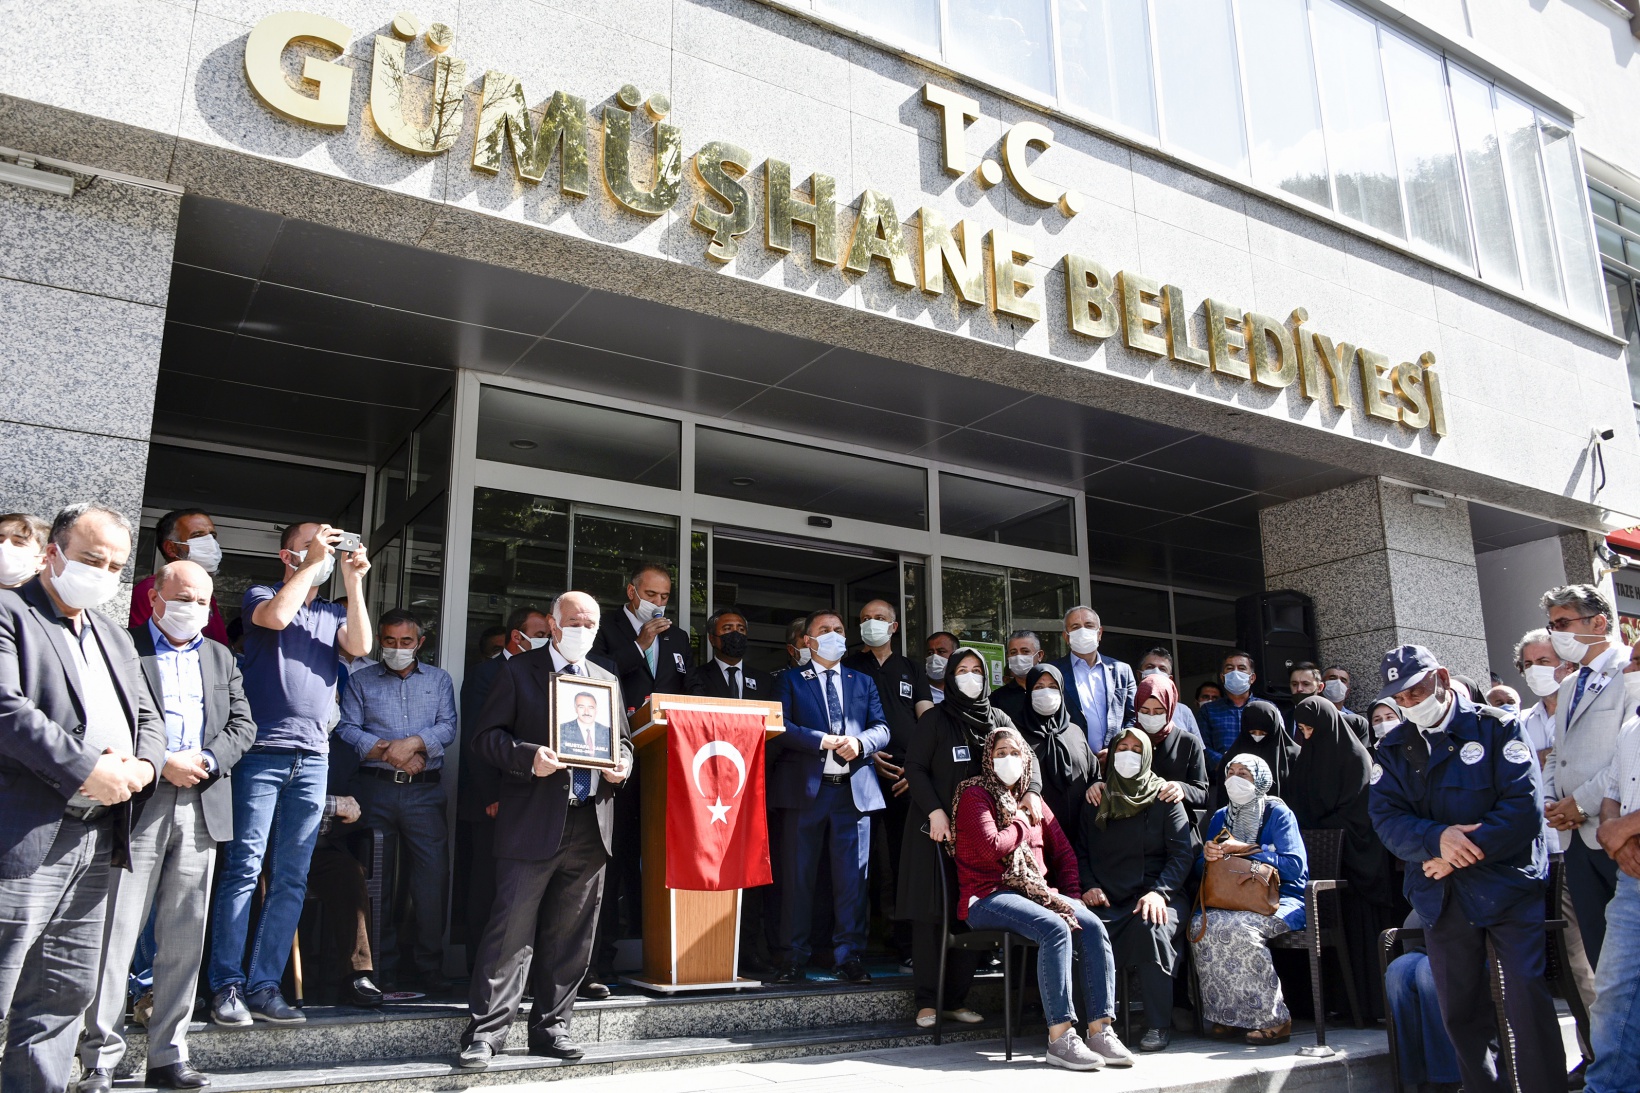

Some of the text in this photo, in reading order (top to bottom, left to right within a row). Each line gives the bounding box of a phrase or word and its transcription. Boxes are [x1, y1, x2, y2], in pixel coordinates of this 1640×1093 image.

[922, 81, 1082, 219] T.C.
[244, 10, 1448, 438] GÜMÜŞHANE BELEDİYESİ
[1615, 582, 1634, 598] TAZE
[1387, 667, 1399, 681] B
